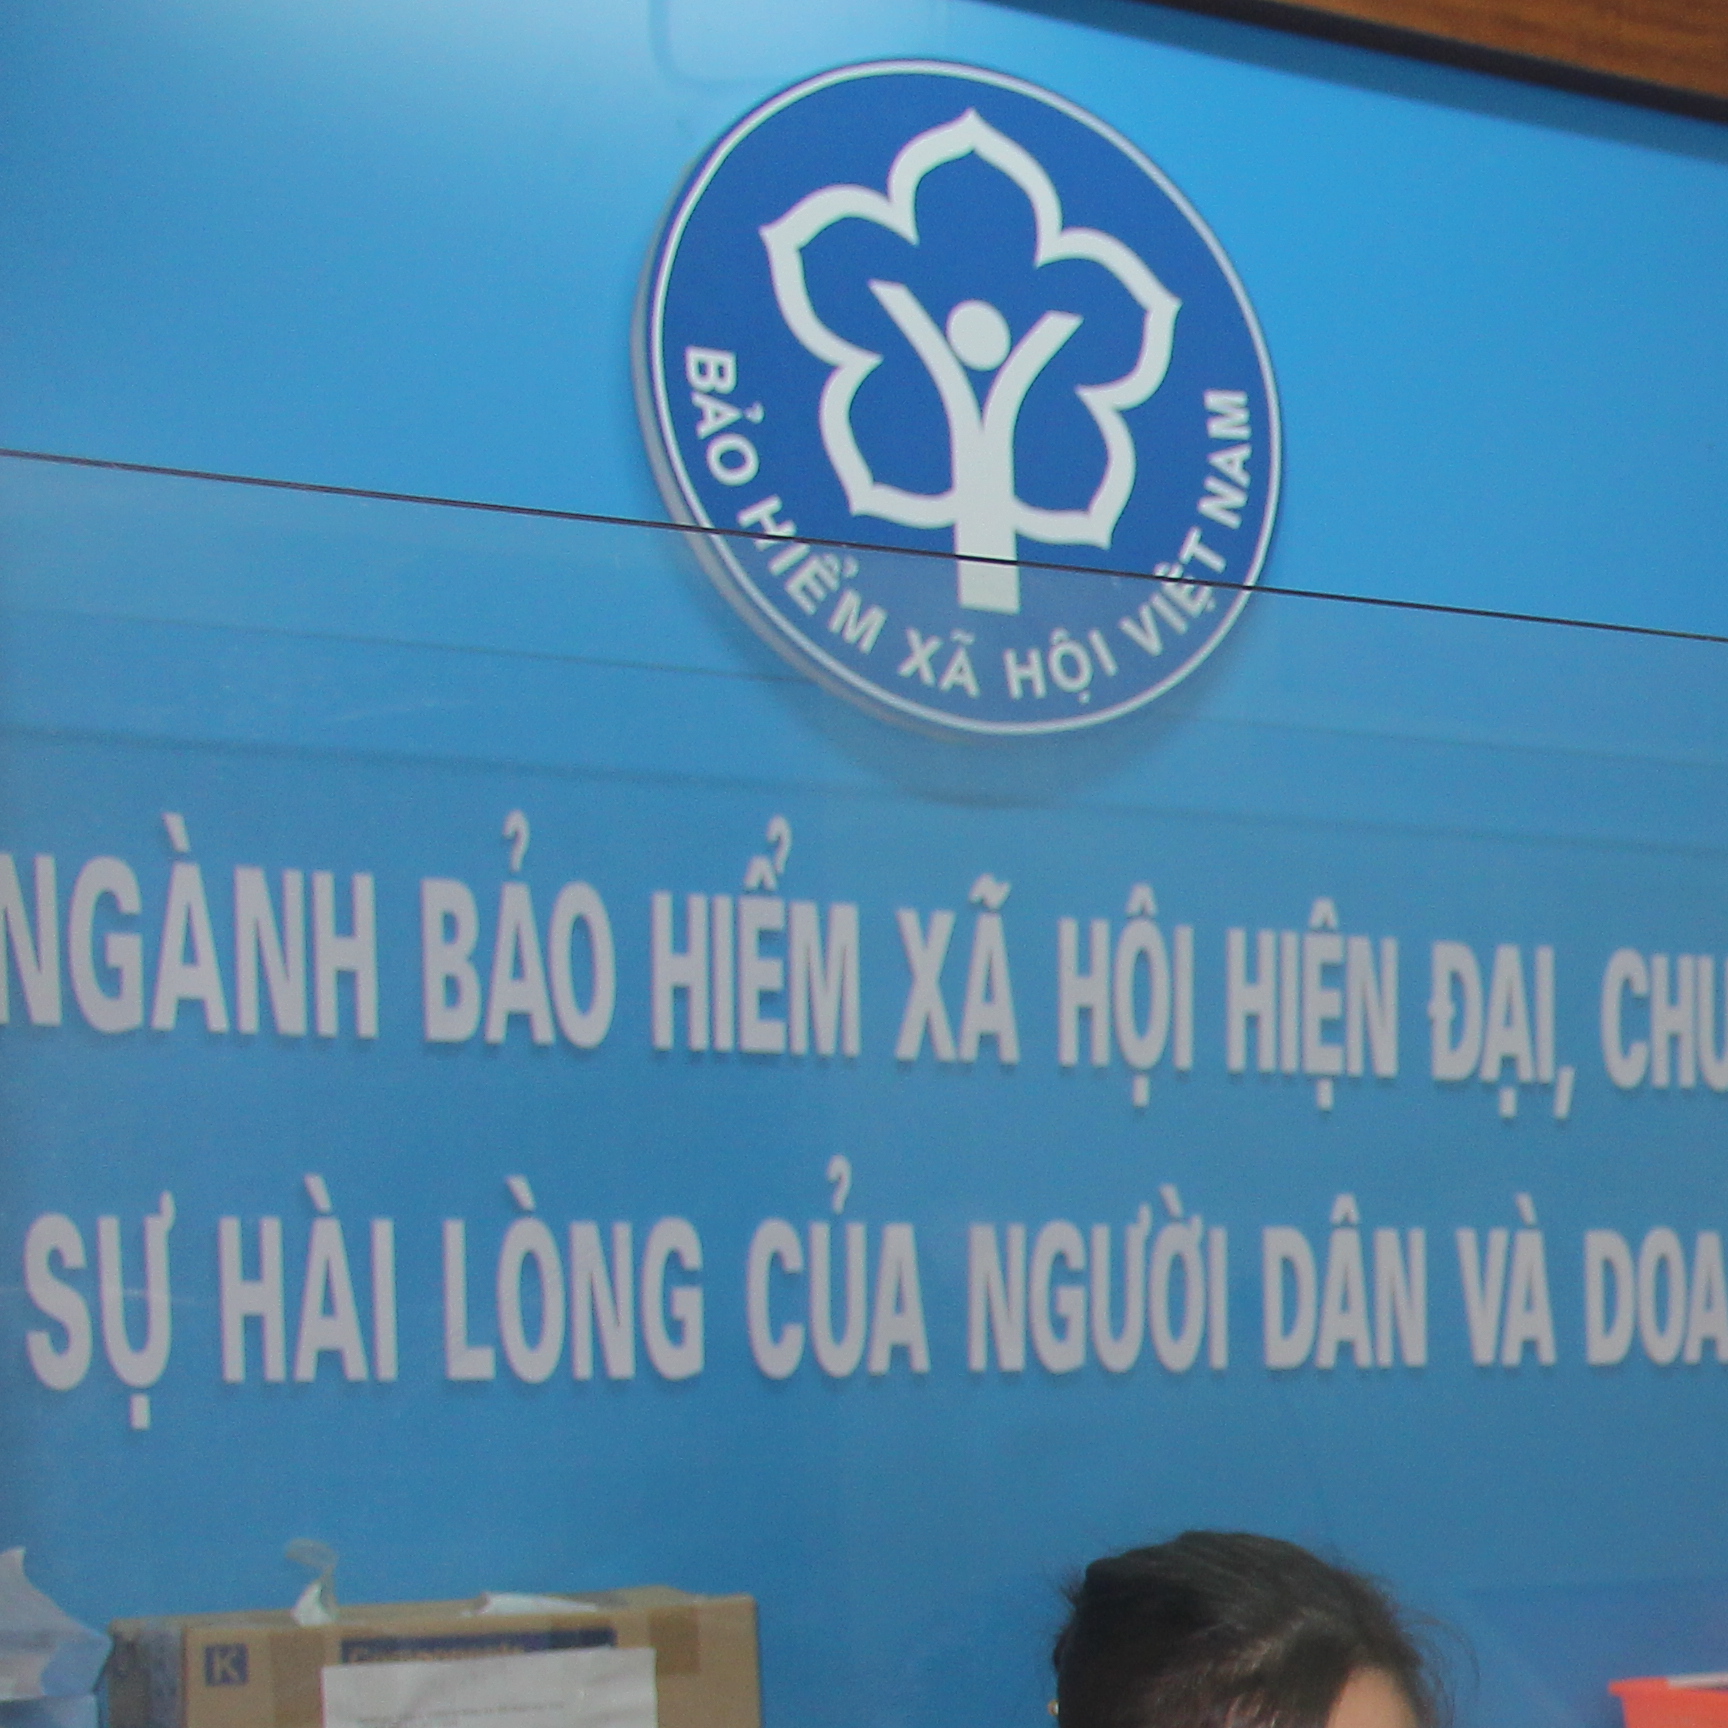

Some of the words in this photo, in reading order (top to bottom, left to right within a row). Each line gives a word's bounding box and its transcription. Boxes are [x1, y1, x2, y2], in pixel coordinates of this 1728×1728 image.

[685, 346, 764, 487] BẢO
[737, 495, 886, 656] HIỂM
[899, 629, 979, 697] XÃ
[1004, 631, 1115, 703] HỘI
[1121, 527, 1226, 657] VIỆT
[1199, 389, 1252, 529] NAM
[0, 813, 379, 1039] NGÀNH
[421, 811, 616, 1049] BẢO
[651, 816, 861, 1058] HIỂM
[895, 874, 1021, 1065] XÃ
[1058, 884, 1194, 1108] HỘI
[1226, 898, 1399, 1110] HIỆN
[1428, 942, 1575, 1119] ĐẠI,
[24, 1192, 176, 1430] SỰ
[218, 1173, 397, 1384] HÀI
[443, 1175, 705, 1385] LÒNG
[747, 1155, 931, 1380] CỦA
[968, 1185, 1229, 1374] NGƯỜI
[1264, 1194, 1427, 1370] DÂN
[1456, 1194, 1557, 1368] VÀ
